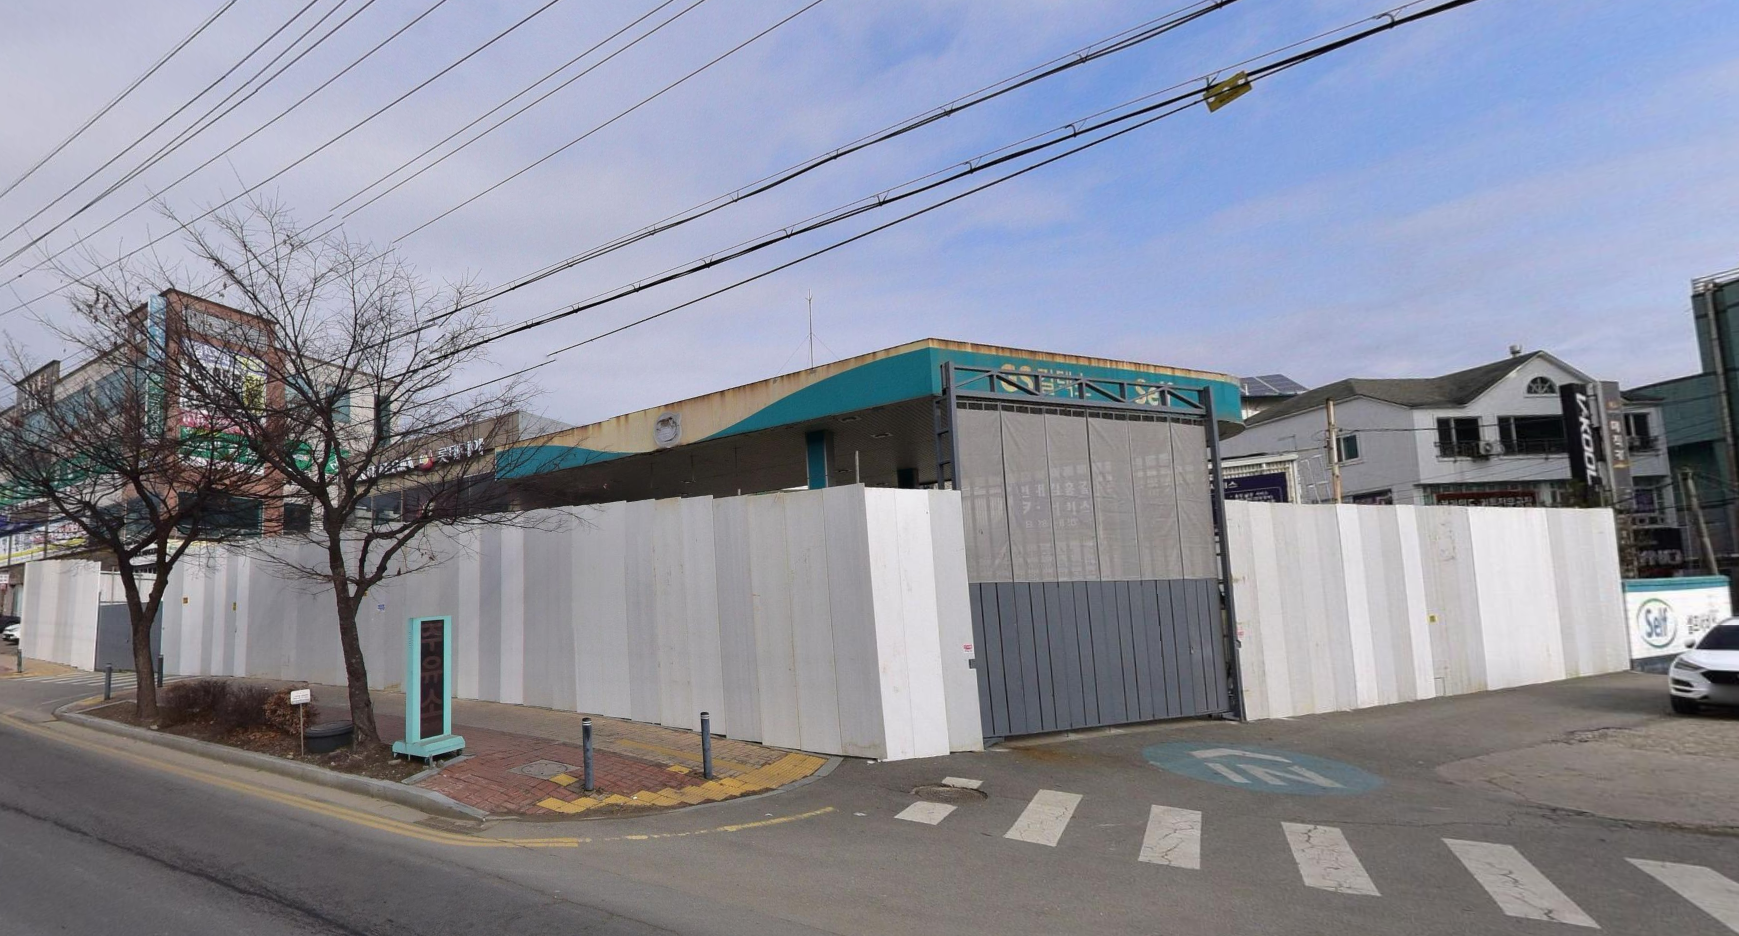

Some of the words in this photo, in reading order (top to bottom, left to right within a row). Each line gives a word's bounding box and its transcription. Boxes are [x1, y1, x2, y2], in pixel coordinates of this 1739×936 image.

[1134, 378, 1174, 407] Sef
[1645, 607, 1668, 638] Self
[420, 621, 444, 718] 주유소
[1204, 762, 1348, 789] IN
